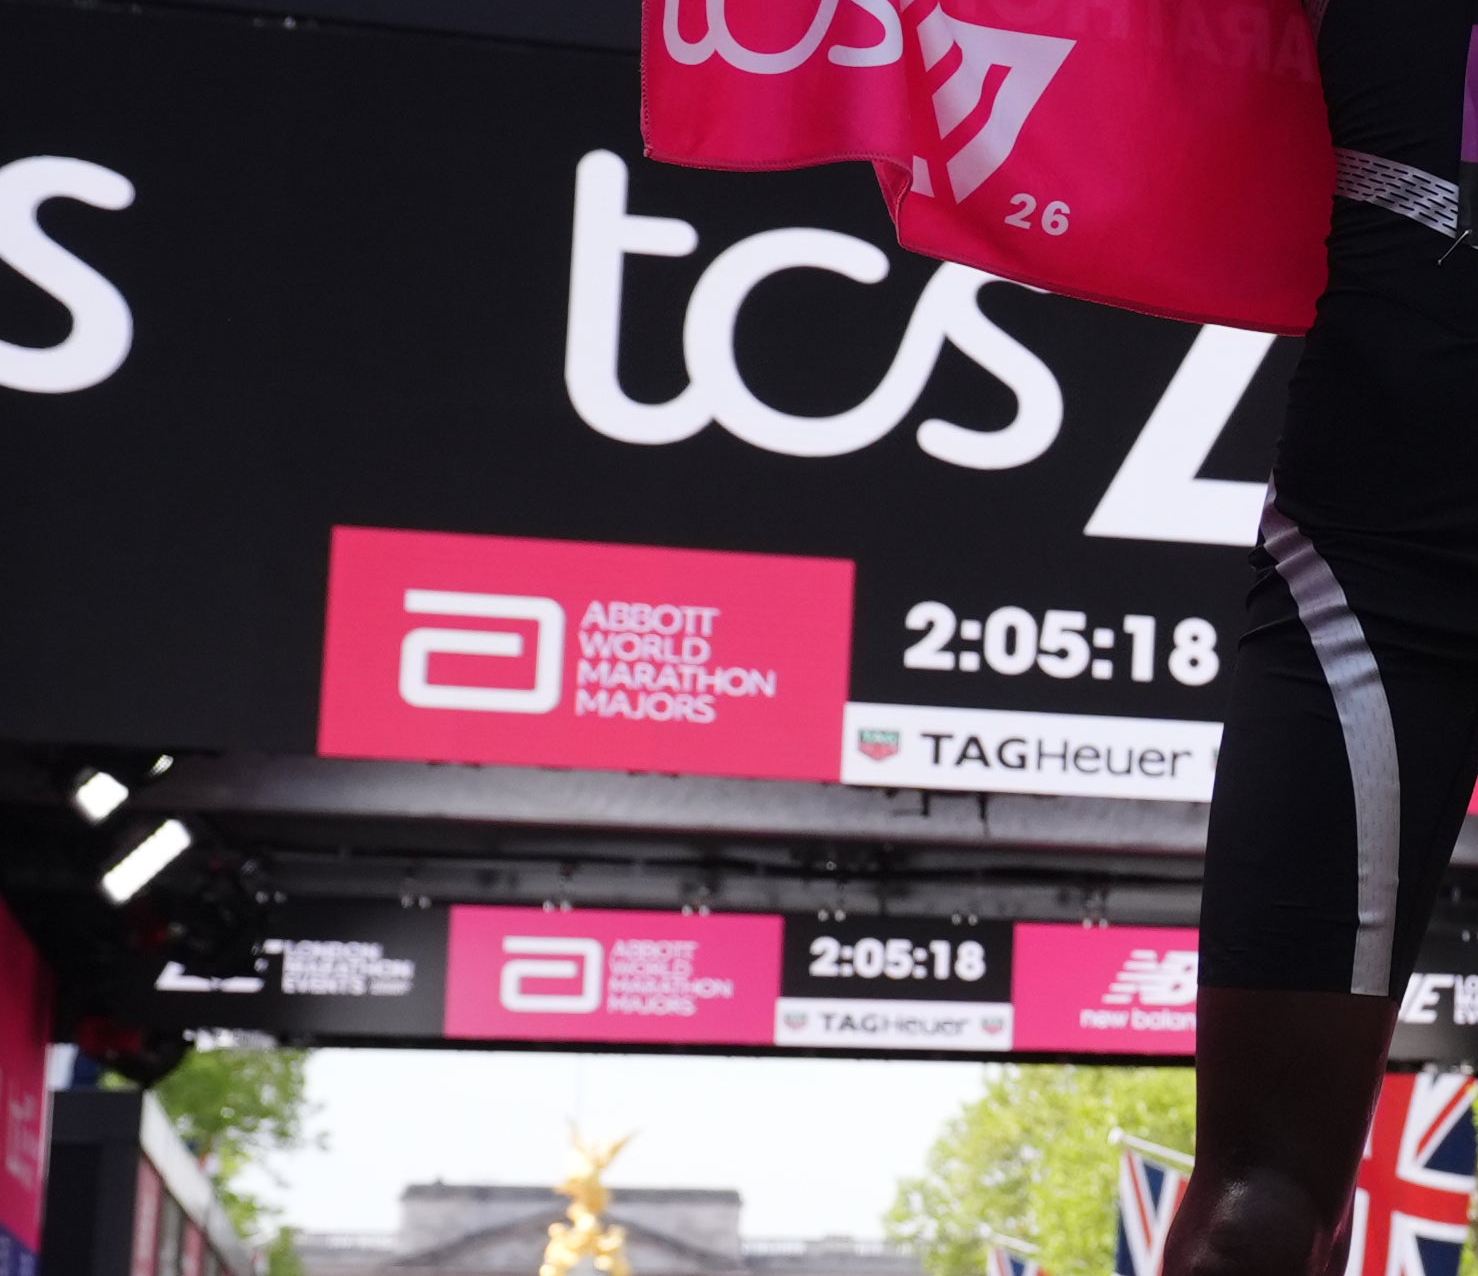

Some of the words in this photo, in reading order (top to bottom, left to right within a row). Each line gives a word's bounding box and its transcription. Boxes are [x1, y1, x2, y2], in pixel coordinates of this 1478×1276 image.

[1004, 192, 1071, 236] 26
[565, 149, 1064, 469] tcs
[581, 600, 721, 638] ABBOTT
[577, 631, 712, 664] WORLD
[904, 601, 1220, 686] 2:05:18
[575, 659, 777, 698] MARATHON
[574, 688, 717, 724] MAJORS
[611, 939, 699, 960] ABBOTT
[809, 936, 987, 982] 2:05:18
[607, 976, 734, 999] MARATHON
[607, 993, 696, 1016] MAJORS
[1079, 1008, 1128, 1029] new
[1132, 1008, 1197, 1032] balan
